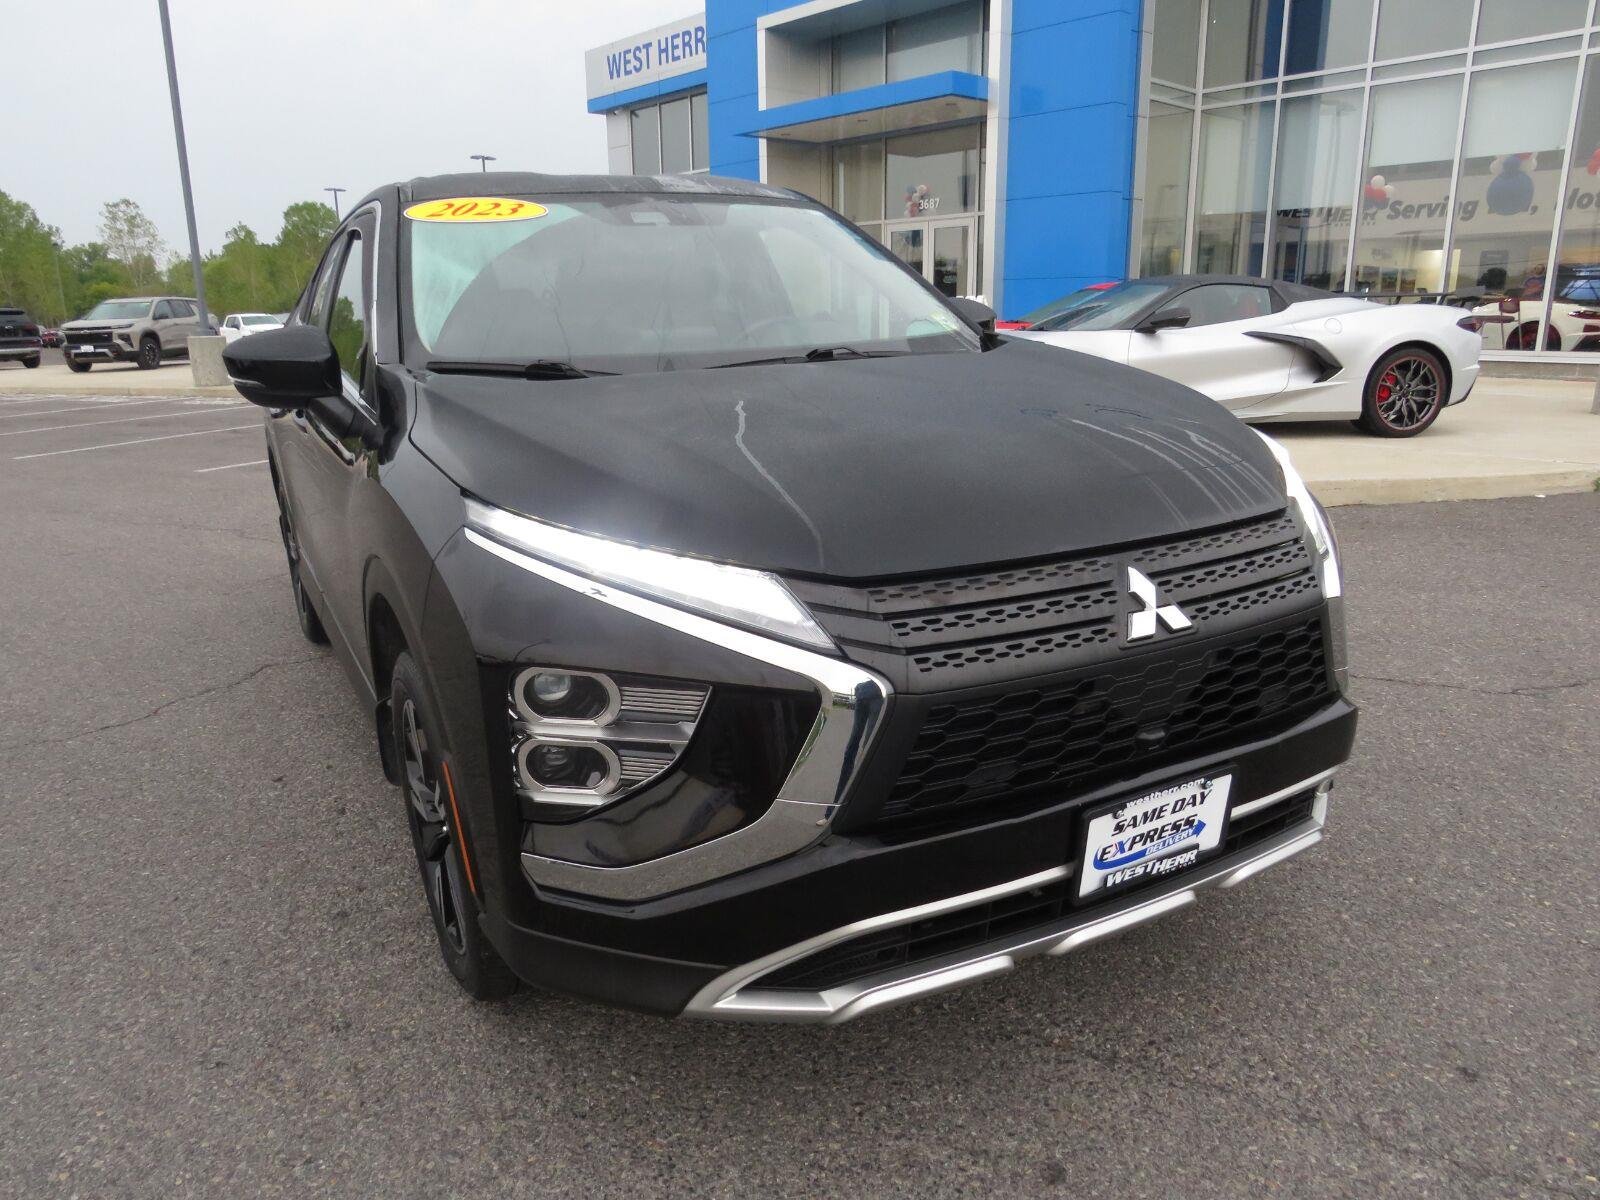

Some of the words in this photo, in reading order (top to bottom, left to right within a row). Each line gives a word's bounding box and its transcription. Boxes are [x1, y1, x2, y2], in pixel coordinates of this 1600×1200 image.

[606, 42, 653, 80] WEST
[657, 26, 706, 66] HERR
[426, 202, 525, 218] 2023
[919, 197, 940, 210] 3687
[1387, 194, 1480, 222] Servig
[1111, 803, 1170, 836] SAME
[1171, 789, 1213, 815] DAY
[1100, 814, 1198, 862] EXPRESS
[1146, 828, 1194, 855] DELIVERY
